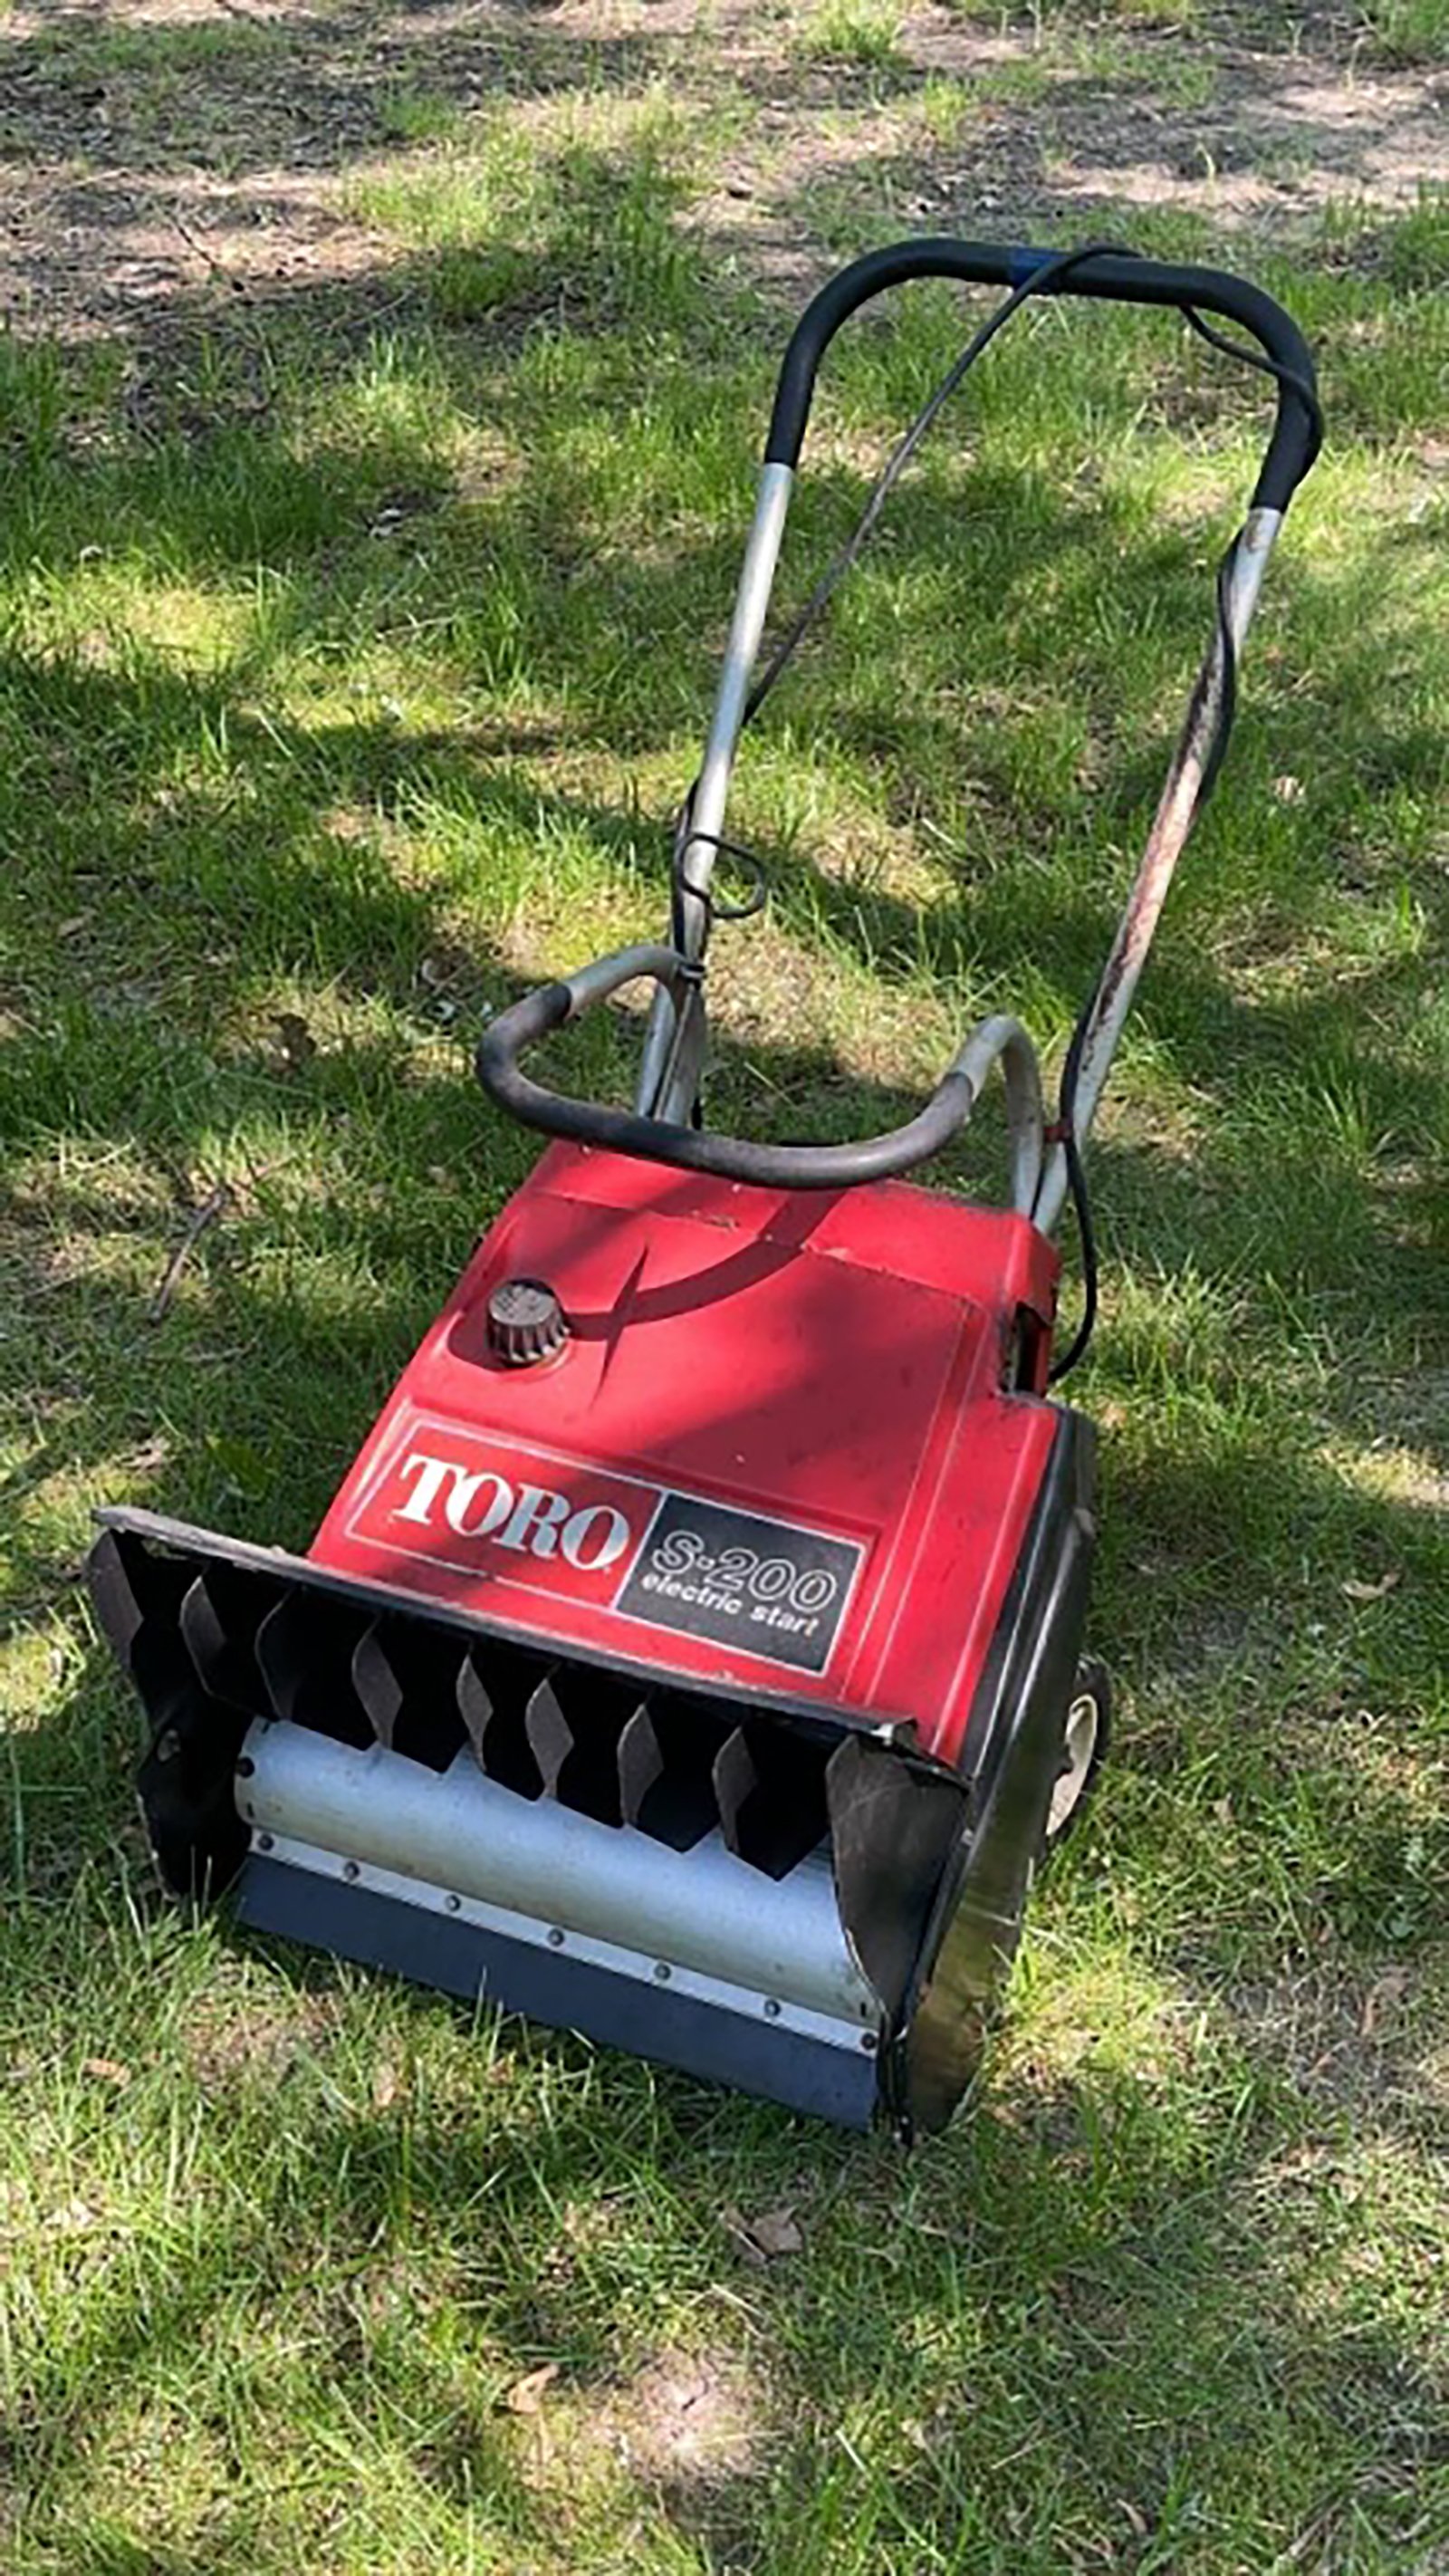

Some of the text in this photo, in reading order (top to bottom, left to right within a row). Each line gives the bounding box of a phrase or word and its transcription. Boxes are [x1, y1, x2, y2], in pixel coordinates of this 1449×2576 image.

[392, 1454, 629, 1570] TORO
[641, 1572, 819, 1636] electric start
[652, 1530, 837, 1613] S-200
